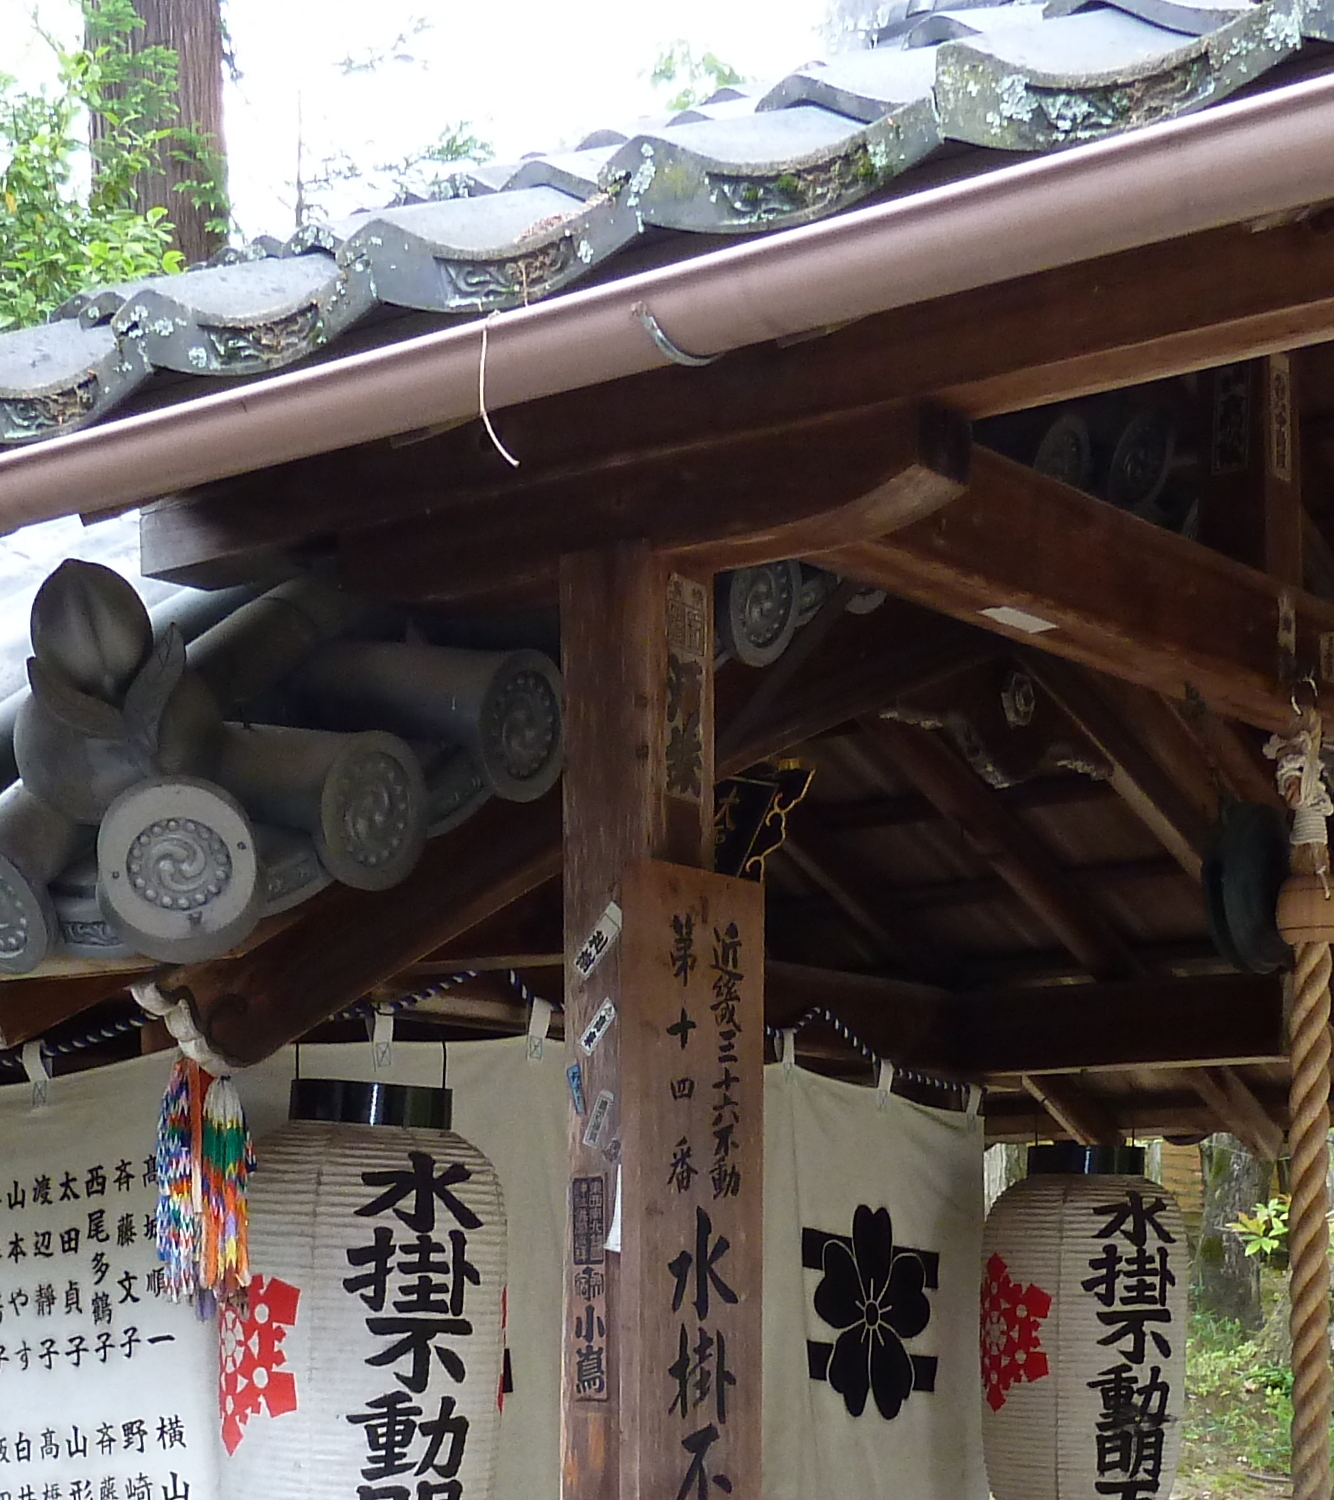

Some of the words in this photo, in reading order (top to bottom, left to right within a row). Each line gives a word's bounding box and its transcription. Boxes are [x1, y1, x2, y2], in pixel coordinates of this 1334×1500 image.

[666, 914, 698, 1193] 第十四番
[7, 1181, 31, 1371] 山本やす
[59, 1171, 89, 1367] 太田貞子
[85, 1165, 115, 1363] 西尾多鶴子
